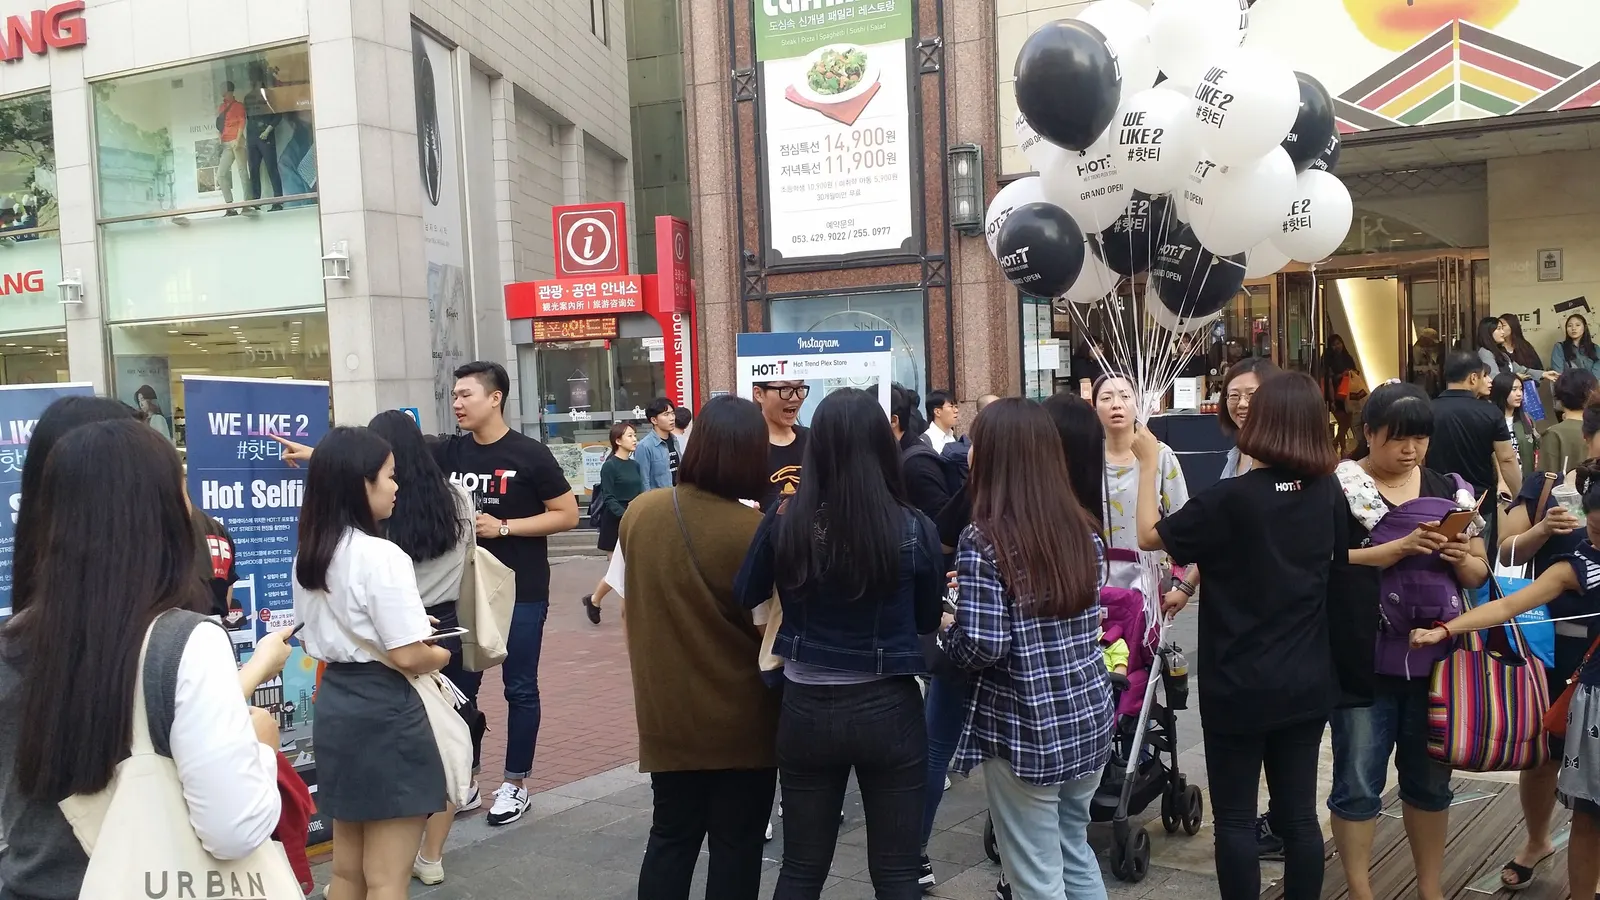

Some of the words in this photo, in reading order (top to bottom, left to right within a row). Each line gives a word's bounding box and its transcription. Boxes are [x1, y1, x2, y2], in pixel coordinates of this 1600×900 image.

[769, 17, 795, 31] 도심속
[799, 13, 825, 27] 신개념
[828, 7, 855, 21] 패밀리
[858, 1, 895, 16] 레스토랑
[0, 0, 87, 62] NG
[781, 38, 796, 46] Steak
[801, 35, 815, 44] Pizza
[820, 29, 845, 41] Spaghetti
[850, 26, 865, 35] Sushi
[870, 22, 886, 31] Salad
[1204, 66, 1228, 85] WE
[1123, 111, 1147, 127] WE
[1196, 105, 1224, 129] #핫티
[780, 140, 820, 156] 점심특선
[1127, 147, 1161, 162] #핫티
[781, 162, 821, 177] 저녁특선
[1077, 154, 1117, 176] HOT:
[1080, 187, 1105, 200] GRAND
[1107, 183, 1124, 194] OPEN
[1287, 199, 1311, 216] E2
[826, 218, 855, 229] 예약문의
[1282, 215, 1312, 233] #핫티
[0, 270, 44, 295] NG
[1166, 270, 1182, 281] OPEN
[538, 285, 563, 299] 관광
[572, 283, 597, 298] 공연
[601, 281, 638, 296] 안내소
[1533, 308, 1540, 325] 1
[798, 336, 840, 352] Instagram
[752, 360, 788, 376] HOT:T
[833, 359, 847, 367] Store
[208, 412, 241, 436] WE
[247, 413, 291, 437] LIKE
[296, 414, 309, 437] 2
[237, 440, 282, 461] #핫티
[202, 480, 244, 510] Hot
[251, 479, 306, 509] Selfi
[1275, 480, 1302, 492] HOT:T
[145, 870, 266, 899] URBAN
